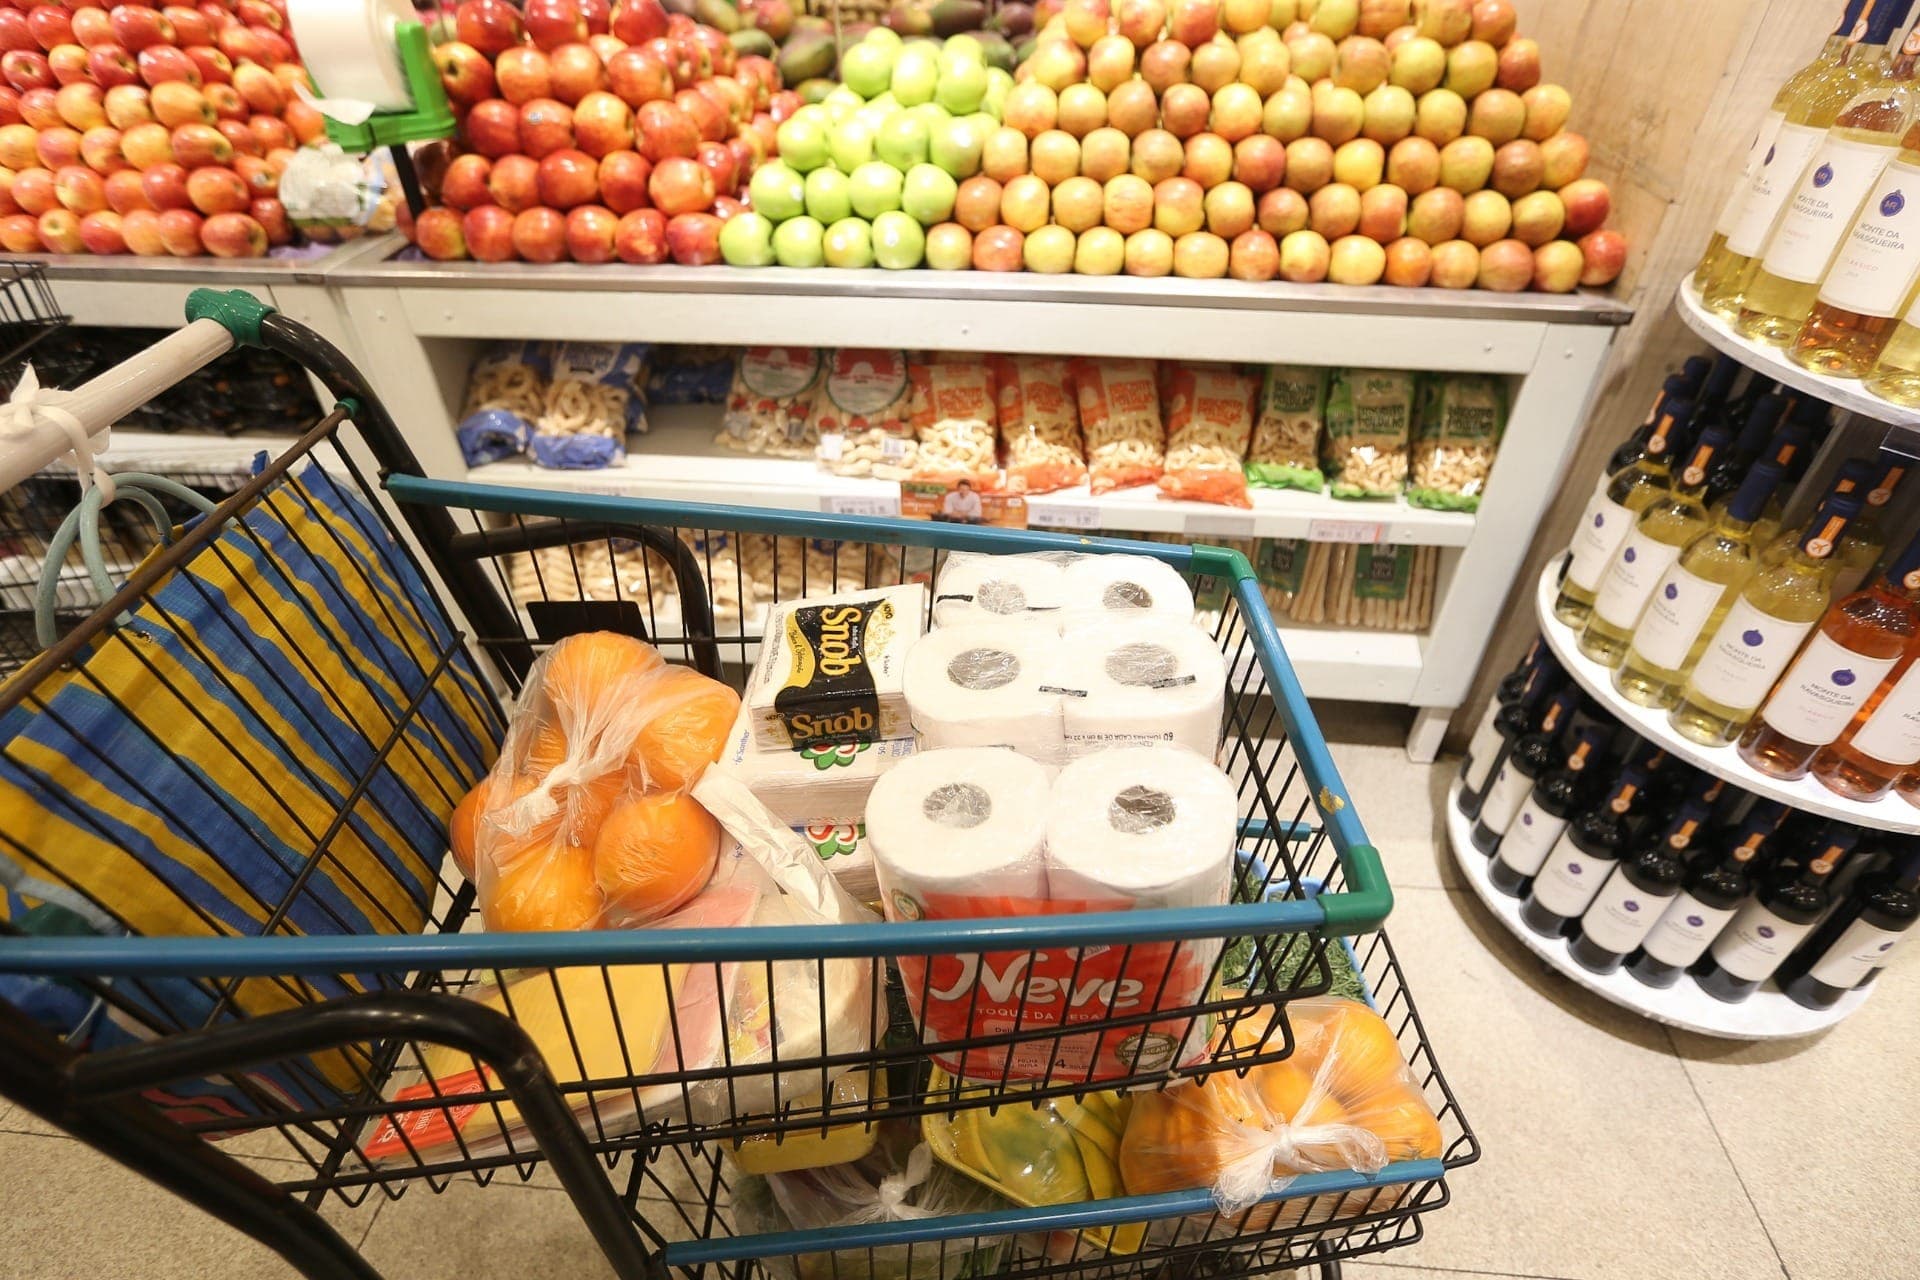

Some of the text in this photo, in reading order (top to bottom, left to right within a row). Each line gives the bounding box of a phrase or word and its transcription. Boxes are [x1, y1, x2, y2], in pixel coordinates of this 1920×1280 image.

[1885, 230, 1900, 239] DA
[819, 606, 863, 677] Snob
[791, 706, 874, 739] Snob
[929, 951, 1145, 1008] Neve
[975, 1007, 1100, 1021] TOQUE DA EDA
[1055, 1058, 1067, 1068] 4
